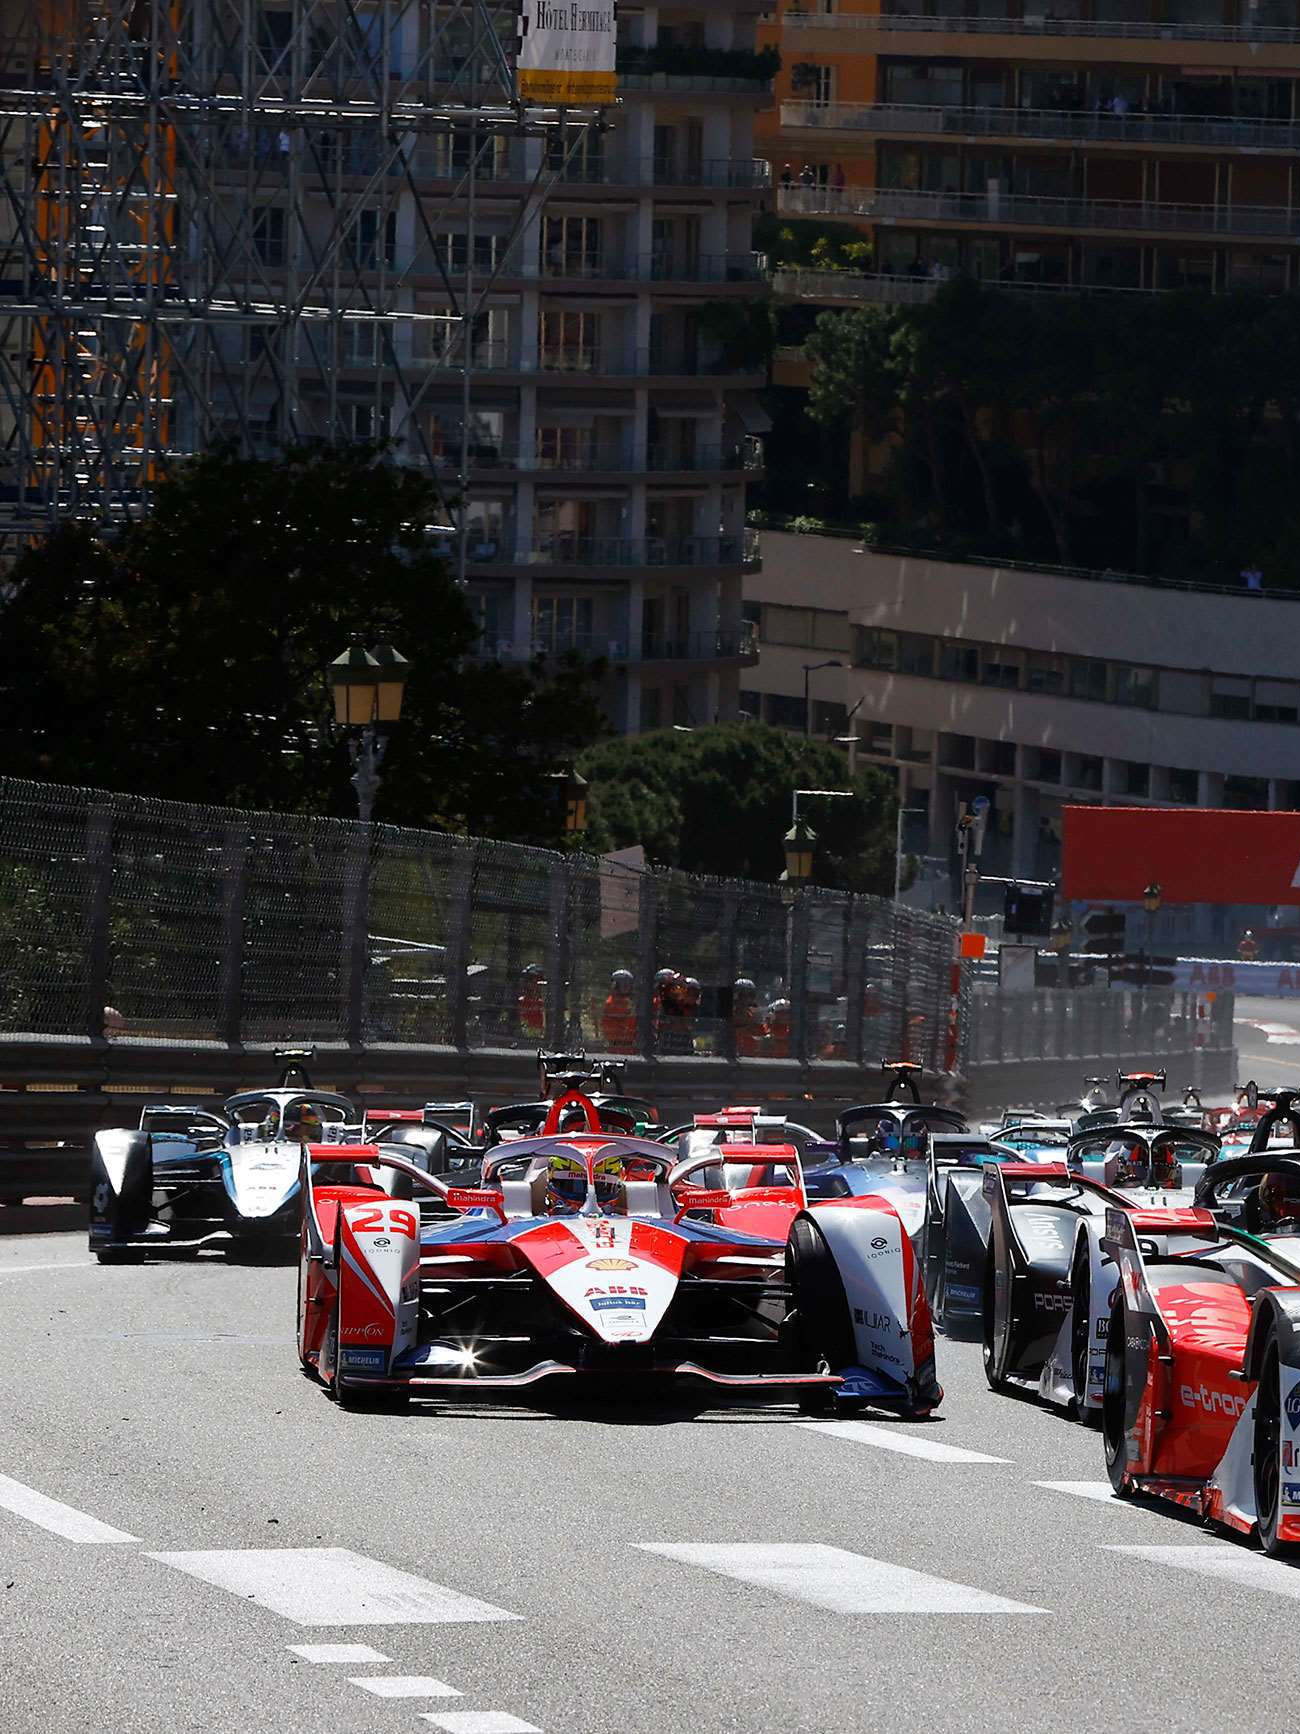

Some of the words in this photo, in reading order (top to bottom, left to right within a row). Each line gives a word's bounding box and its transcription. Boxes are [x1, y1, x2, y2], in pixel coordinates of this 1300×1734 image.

[351, 1208, 417, 1240] 29
[584, 1286, 648, 1297] ABB
[1034, 1293, 1073, 1312] PORS
[348, 1355, 380, 1365] MICHELIN
[1181, 1384, 1246, 1416] e-tron
